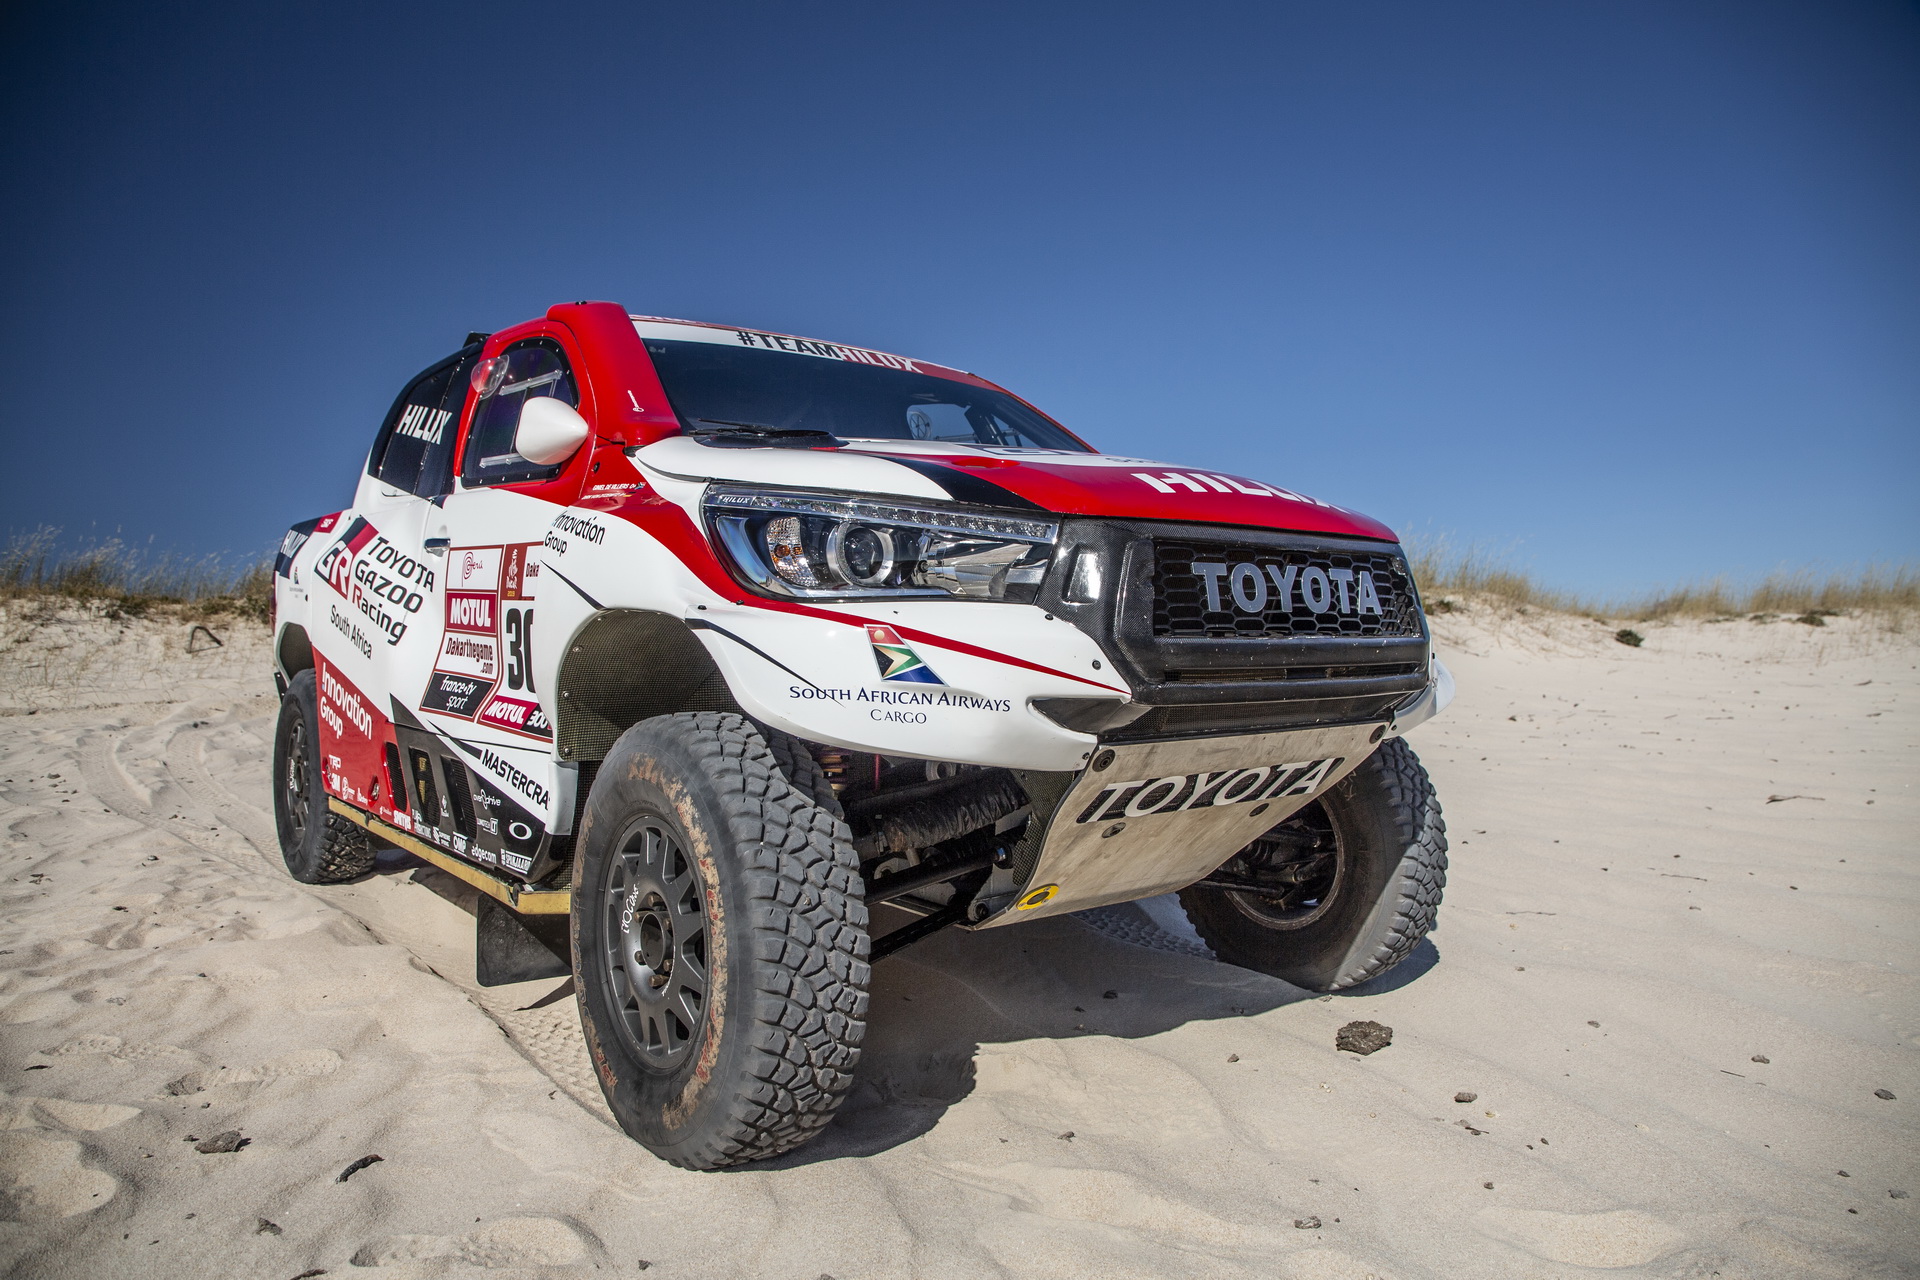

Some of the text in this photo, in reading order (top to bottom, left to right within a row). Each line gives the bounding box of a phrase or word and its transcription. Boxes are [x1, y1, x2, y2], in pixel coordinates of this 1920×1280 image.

[736, 331, 923, 373] #TEAMHILUX
[396, 404, 453, 445] HILUX
[723, 496, 750, 504] HILUX
[544, 531, 567, 557] Group
[552, 511, 605, 545] Innovation
[368, 537, 435, 593] TOYOTA
[354, 560, 424, 614] GAZOO
[1191, 561, 1383, 615] TOYOTA
[330, 604, 373, 660] South Africa
[352, 584, 408, 646] Racing
[450, 597, 491, 627] MOTUL
[445, 637, 493, 663] Dakarthegame
[320, 696, 344, 739] Group
[322, 662, 372, 740] Innovation
[446, 695, 469, 712] sport
[484, 699, 528, 725] MOTUL
[870, 708, 927, 724] CARGO
[482, 749, 551, 810] MASTERCRA
[1079, 757, 1343, 824] TOYOTA
